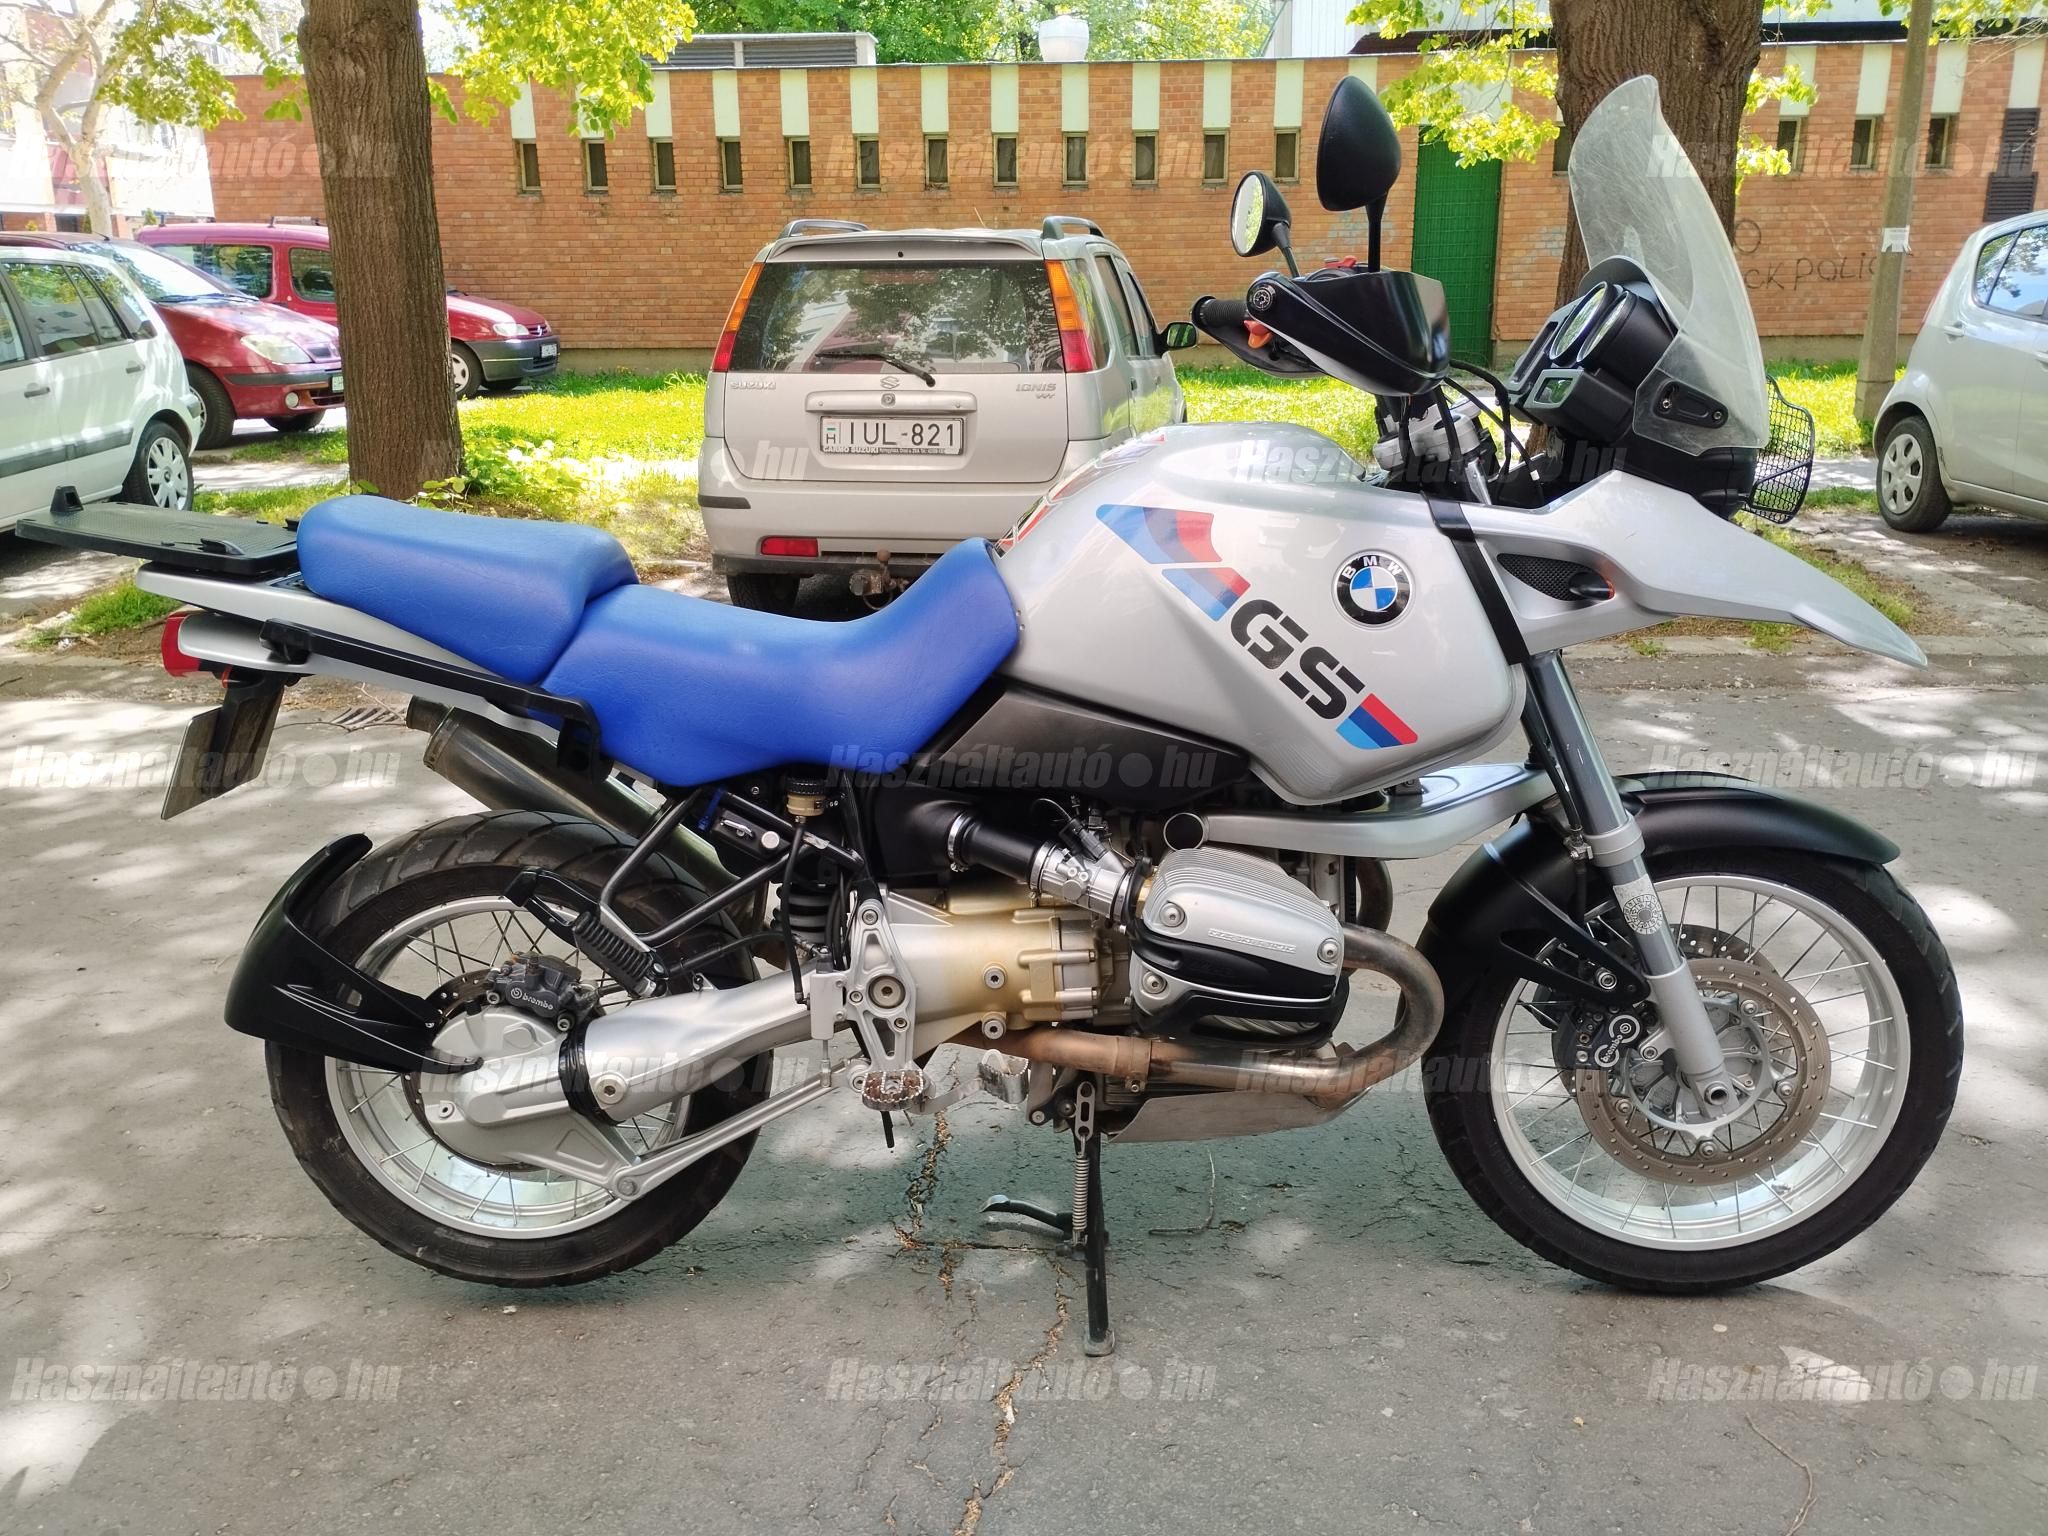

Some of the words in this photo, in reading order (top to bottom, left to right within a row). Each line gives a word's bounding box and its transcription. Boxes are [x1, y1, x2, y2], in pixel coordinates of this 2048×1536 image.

[1794, 252, 1914, 290] POLIC
[730, 381, 777, 391] SUZUKI
[1016, 383, 1057, 392] IGNIS
[850, 421, 954, 447] IUL-821
[1341, 555, 1403, 580] BMW
[1230, 599, 1366, 720] GS
[522, 993, 554, 1010] brembo
[1600, 1034, 1623, 1062] brembo
